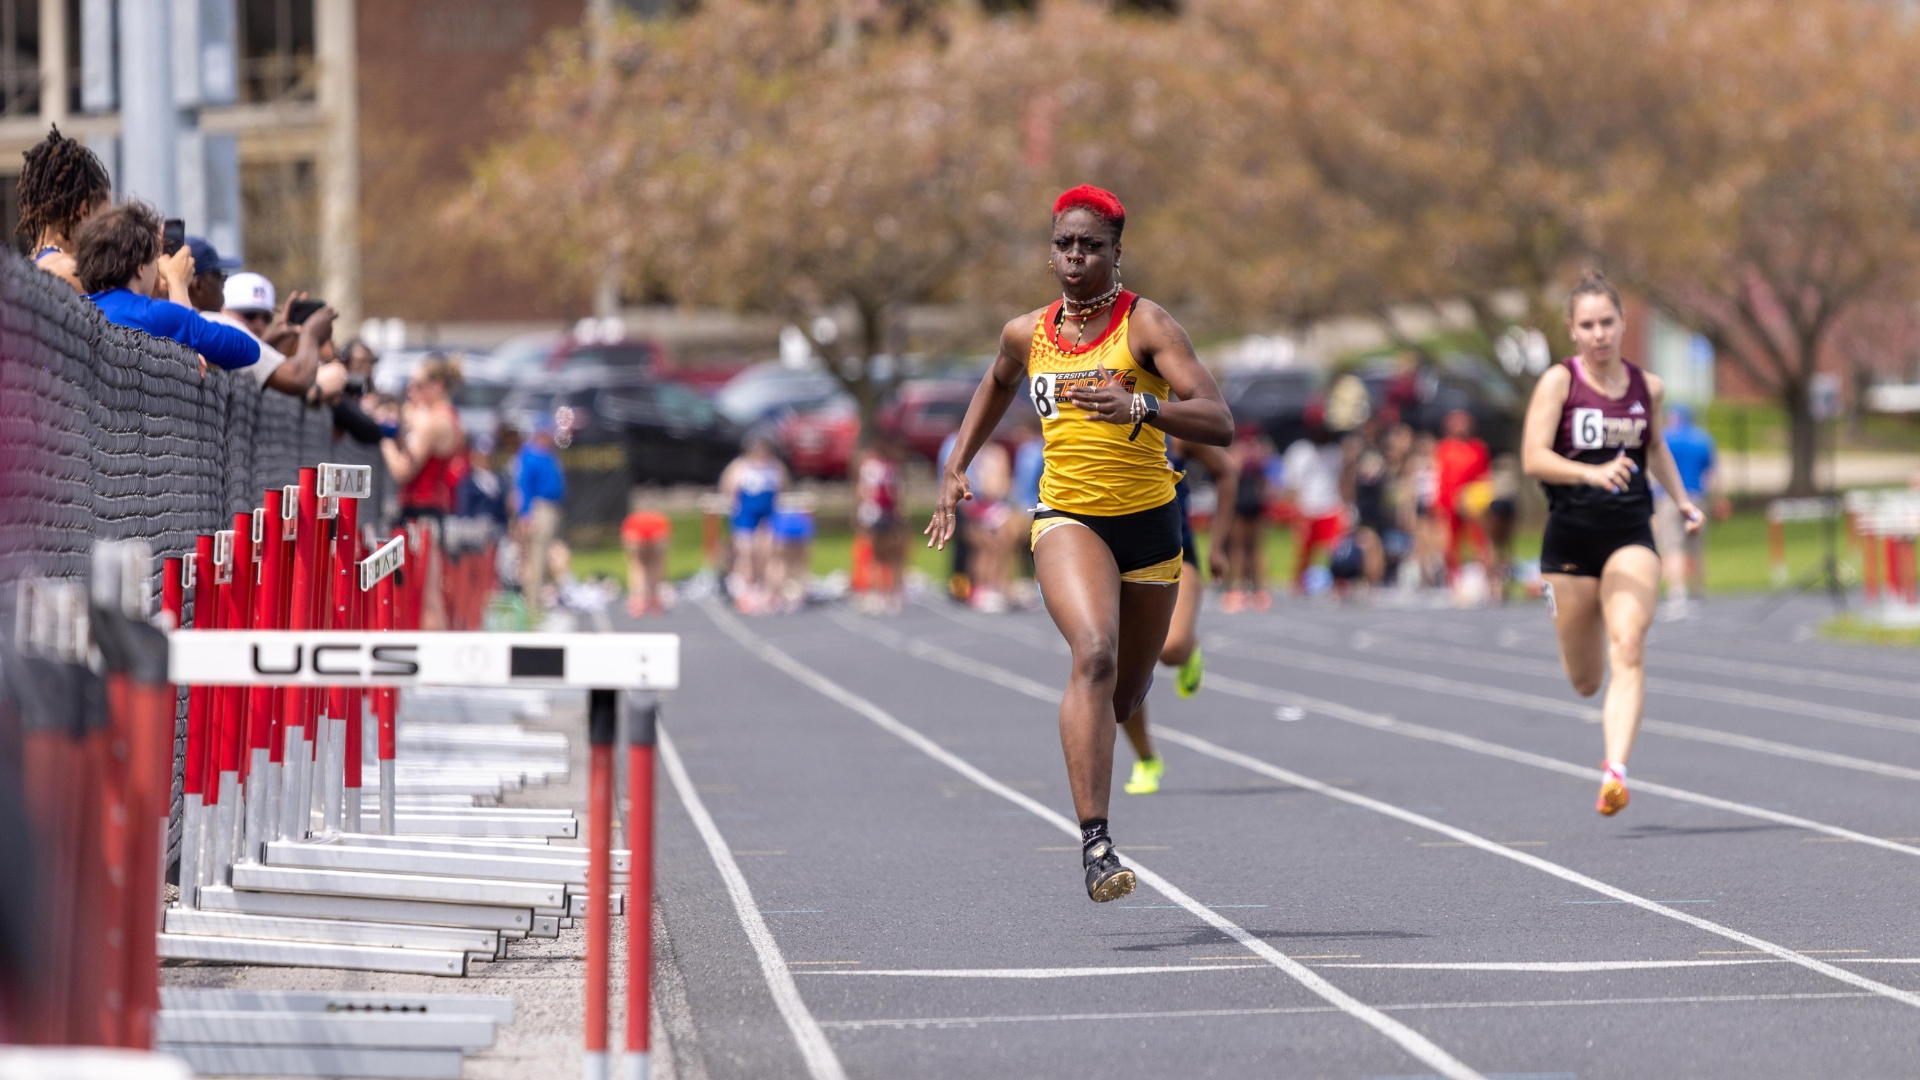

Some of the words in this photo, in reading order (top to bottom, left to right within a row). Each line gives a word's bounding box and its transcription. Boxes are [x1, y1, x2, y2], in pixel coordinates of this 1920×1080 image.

[1055, 371, 1087, 379] VERSITY
[1035, 376, 1052, 417] 8
[1582, 413, 1597, 444] 6
[252, 643, 419, 676] UCS
